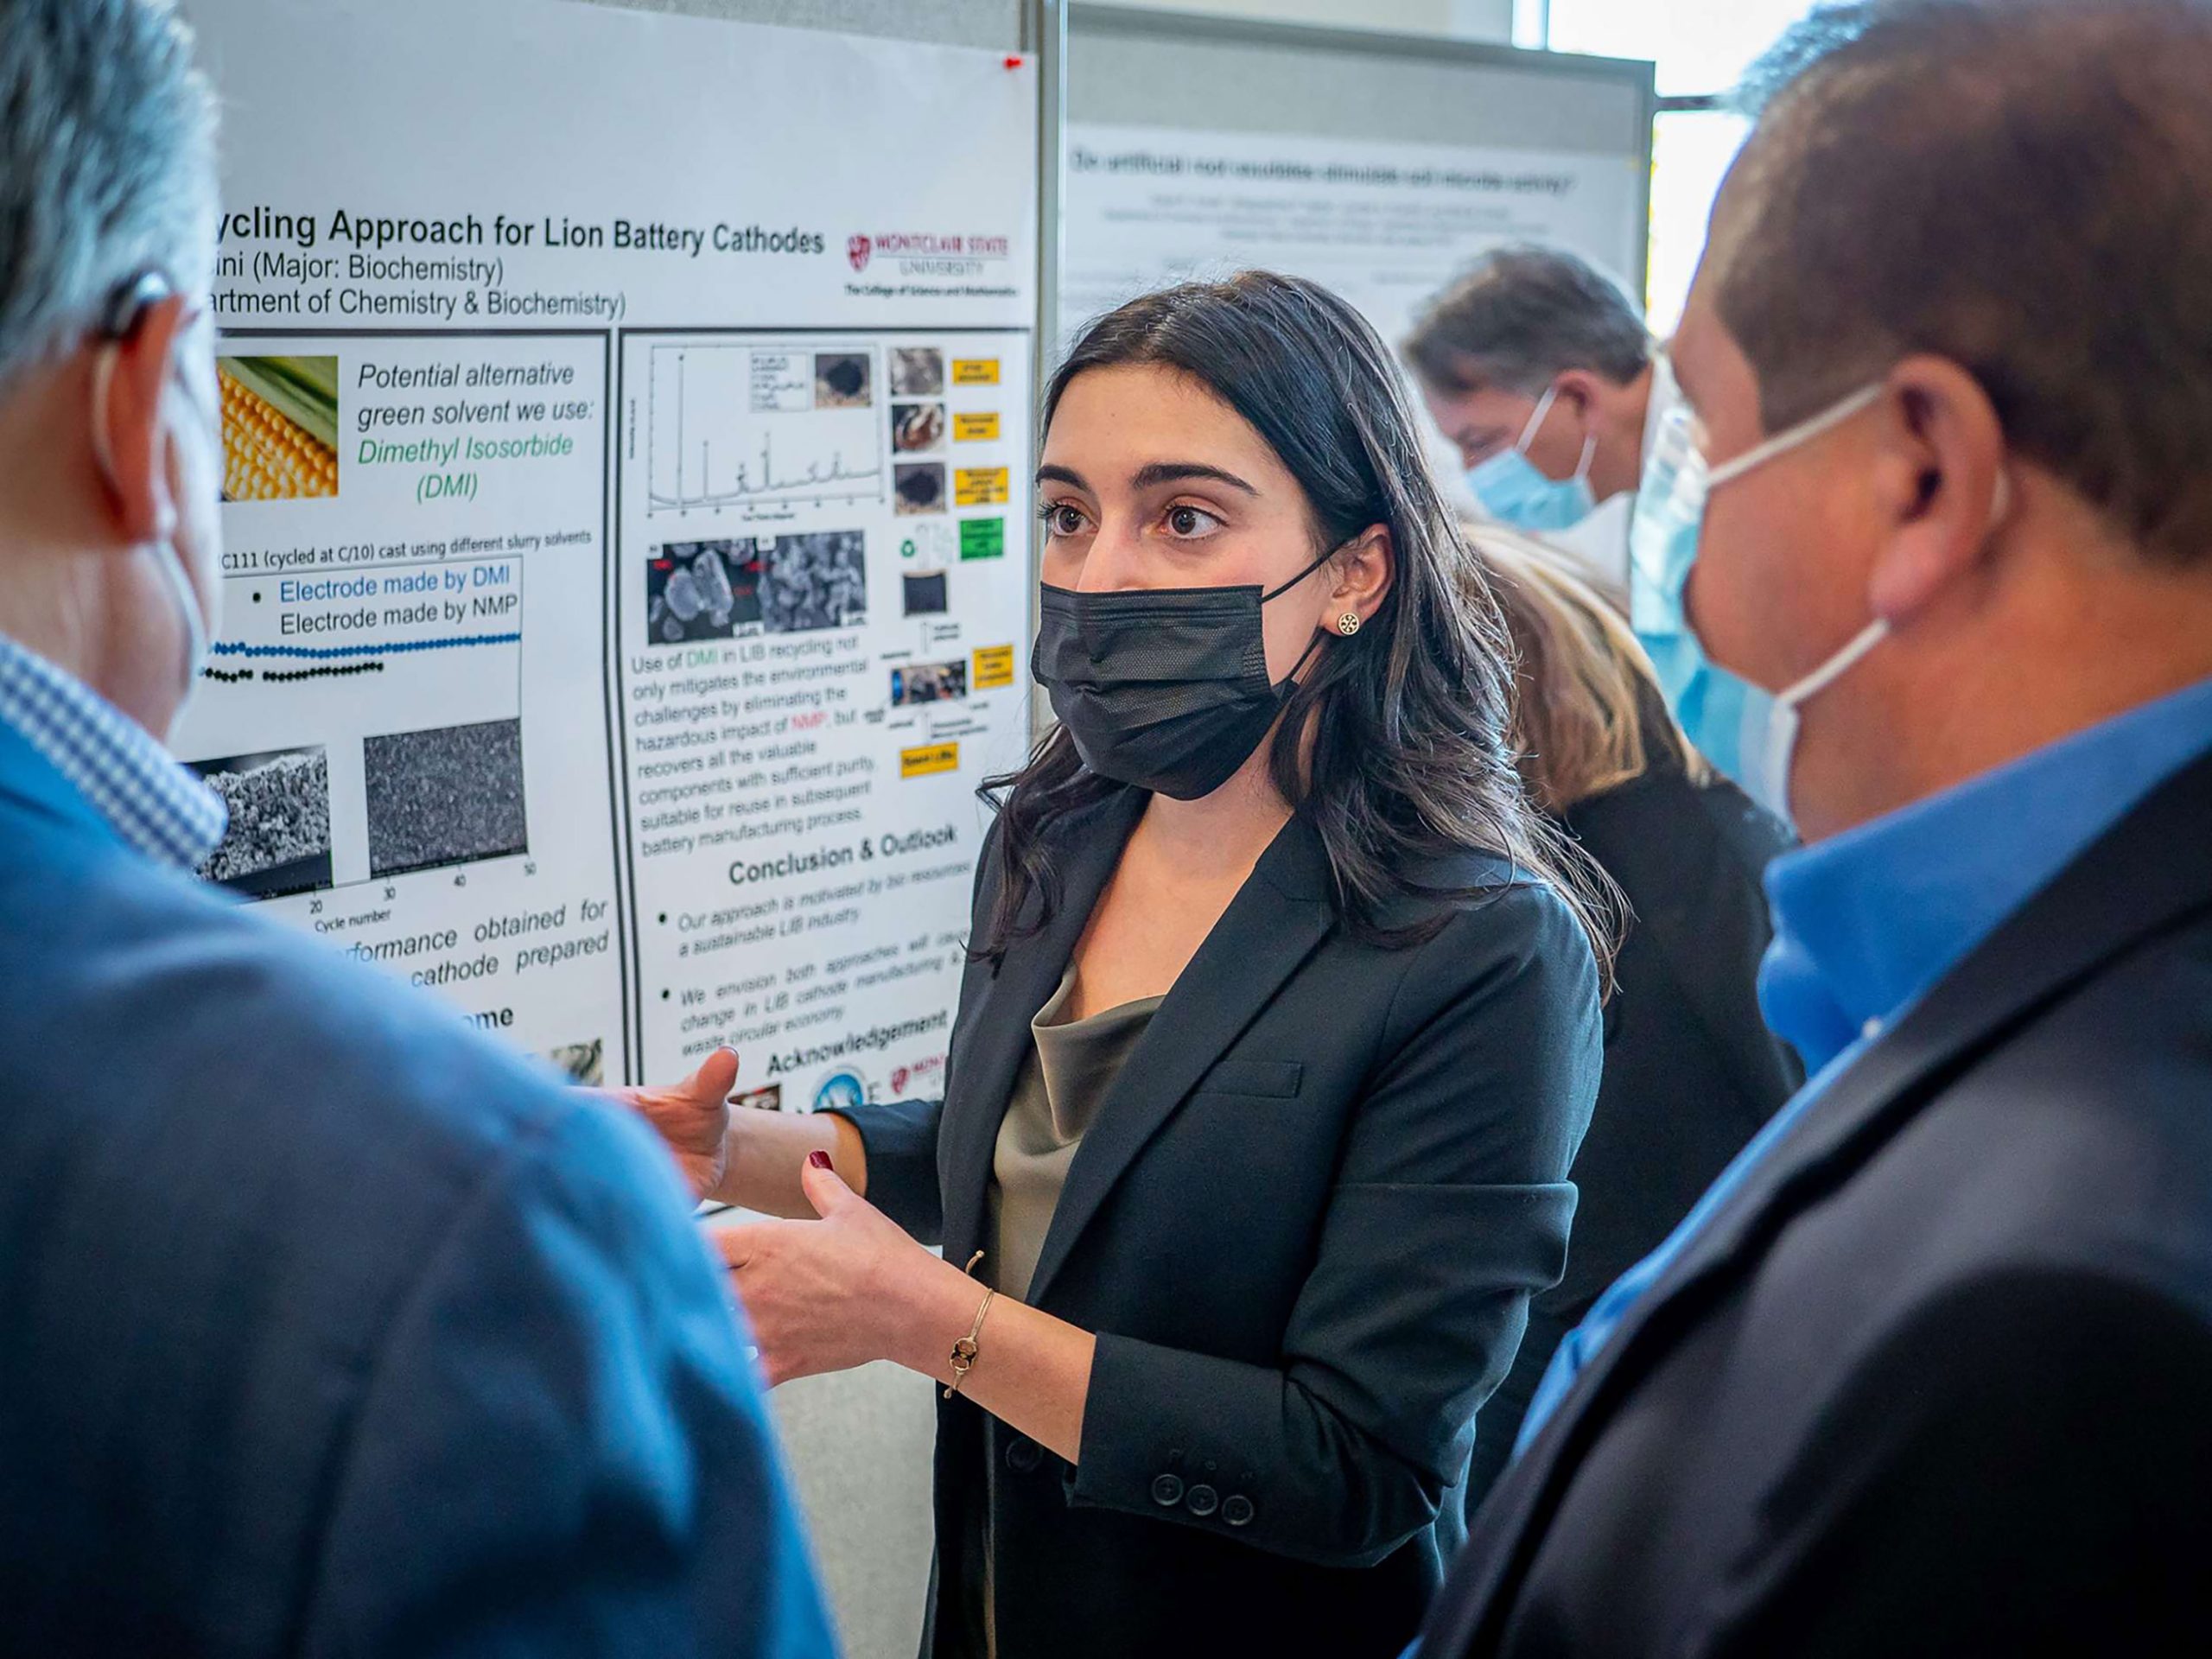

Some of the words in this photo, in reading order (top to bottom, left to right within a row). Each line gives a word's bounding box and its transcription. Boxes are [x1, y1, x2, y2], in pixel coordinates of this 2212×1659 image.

[328, 209, 482, 249] Approach
[494, 214, 534, 245] for
[545, 217, 603, 248] Lion
[613, 219, 705, 257] Battery
[712, 223, 825, 253] Cathodes
[253, 251, 340, 284] (Major:
[348, 254, 504, 287] Biochemistry)
[308, 288, 333, 314] of
[339, 288, 457, 321] Chemistry
[464, 292, 479, 315] &
[488, 291, 626, 321] Biochemistry)
[358, 363, 460, 389] Potential
[466, 364, 575, 387] alternative
[357, 404, 425, 433] green
[432, 402, 510, 425] solvent
[518, 404, 545, 421] we
[551, 403, 594, 420] use:
[357, 436, 459, 466] Dimethyl
[466, 433, 574, 460] Isosorbide
[416, 473, 479, 504] (DMI)
[221, 552, 258, 570] C111
[264, 547, 315, 571] (cycled
[320, 548, 334, 563] at
[337, 542, 375, 564] C/10)
[378, 543, 406, 560] cast
[411, 542, 446, 560] using
[450, 535, 503, 554] different
[507, 532, 542, 552] slurry
[544, 529, 592, 547] solvents
[280, 578, 378, 603] Electrode
[383, 572, 438, 595] made
[445, 568, 467, 591] by
[473, 564, 510, 588] DMI
[280, 609, 378, 635] Electrode
[383, 603, 438, 625] made
[445, 598, 467, 621] by
[473, 593, 518, 618] NMP
[632, 654, 663, 674] Use
[667, 654, 683, 671] of
[686, 648, 718, 668] DMI
[723, 649, 735, 663] in
[740, 643, 766, 663] LIB
[770, 640, 832, 660] recycling
[837, 635, 859, 650] not
[632, 682, 666, 702] only
[671, 674, 739, 695] mitigates
[742, 671, 765, 686] the
[769, 658, 868, 680] environmental
[634, 703, 718, 727] challenges
[721, 699, 740, 715] by
[744, 690, 822, 711] eliminating
[824, 686, 847, 702] the
[635, 729, 718, 753] hazardous
[721, 719, 772, 740] impact
[774, 715, 789, 731] of
[834, 709, 855, 724] but
[637, 758, 704, 779] recovers
[707, 750, 724, 769] all
[729, 748, 753, 764] the
[758, 741, 817, 760] valuable
[639, 778, 732, 806] components
[737, 772, 767, 788] with
[771, 760, 832, 785] sufficient
[640, 808, 701, 831] suitable
[703, 803, 724, 821] for
[728, 799, 770, 816] reuse
[773, 794, 788, 809] in
[791, 780, 871, 805] subsequent
[641, 835, 695, 858] battery
[698, 816, 804, 846] manufacturing
[728, 845, 854, 886] Conclusion
[860, 838, 874, 860] &
[880, 823, 957, 858] Outlook
[309, 900, 324, 915] 20
[384, 887, 397, 901] 30
[454, 874, 467, 887] 40
[524, 862, 537, 876] 50
[677, 912, 707, 932] Our
[710, 899, 779, 927] approach
[784, 895, 795, 910] is
[799, 880, 865, 906] motivated
[867, 878, 883, 894] by
[314, 917, 346, 934] Cycle
[348, 910, 391, 926] number
[474, 905, 566, 944] obtained
[580, 897, 609, 923] for
[678, 942, 690, 957] a
[694, 923, 776, 955] sustainable
[779, 915, 804, 937] LIB
[410, 953, 499, 988] cathode
[514, 931, 610, 975] prepared
[680, 988, 706, 1007] We
[715, 973, 778, 999] envision
[785, 963, 817, 983] both
[824, 944, 899, 974] approaches
[909, 933, 931, 952] will
[680, 1007, 736, 1033] change
[744, 1001, 758, 1017] in
[764, 992, 790, 1014] LIB
[795, 980, 849, 1006] cathode
[853, 956, 944, 988] manufacturing
[682, 1035, 726, 1057] waste
[729, 1022, 779, 1046] circular
[784, 1004, 846, 1030] economy
[766, 1008, 949, 1077] Acknowledgement
